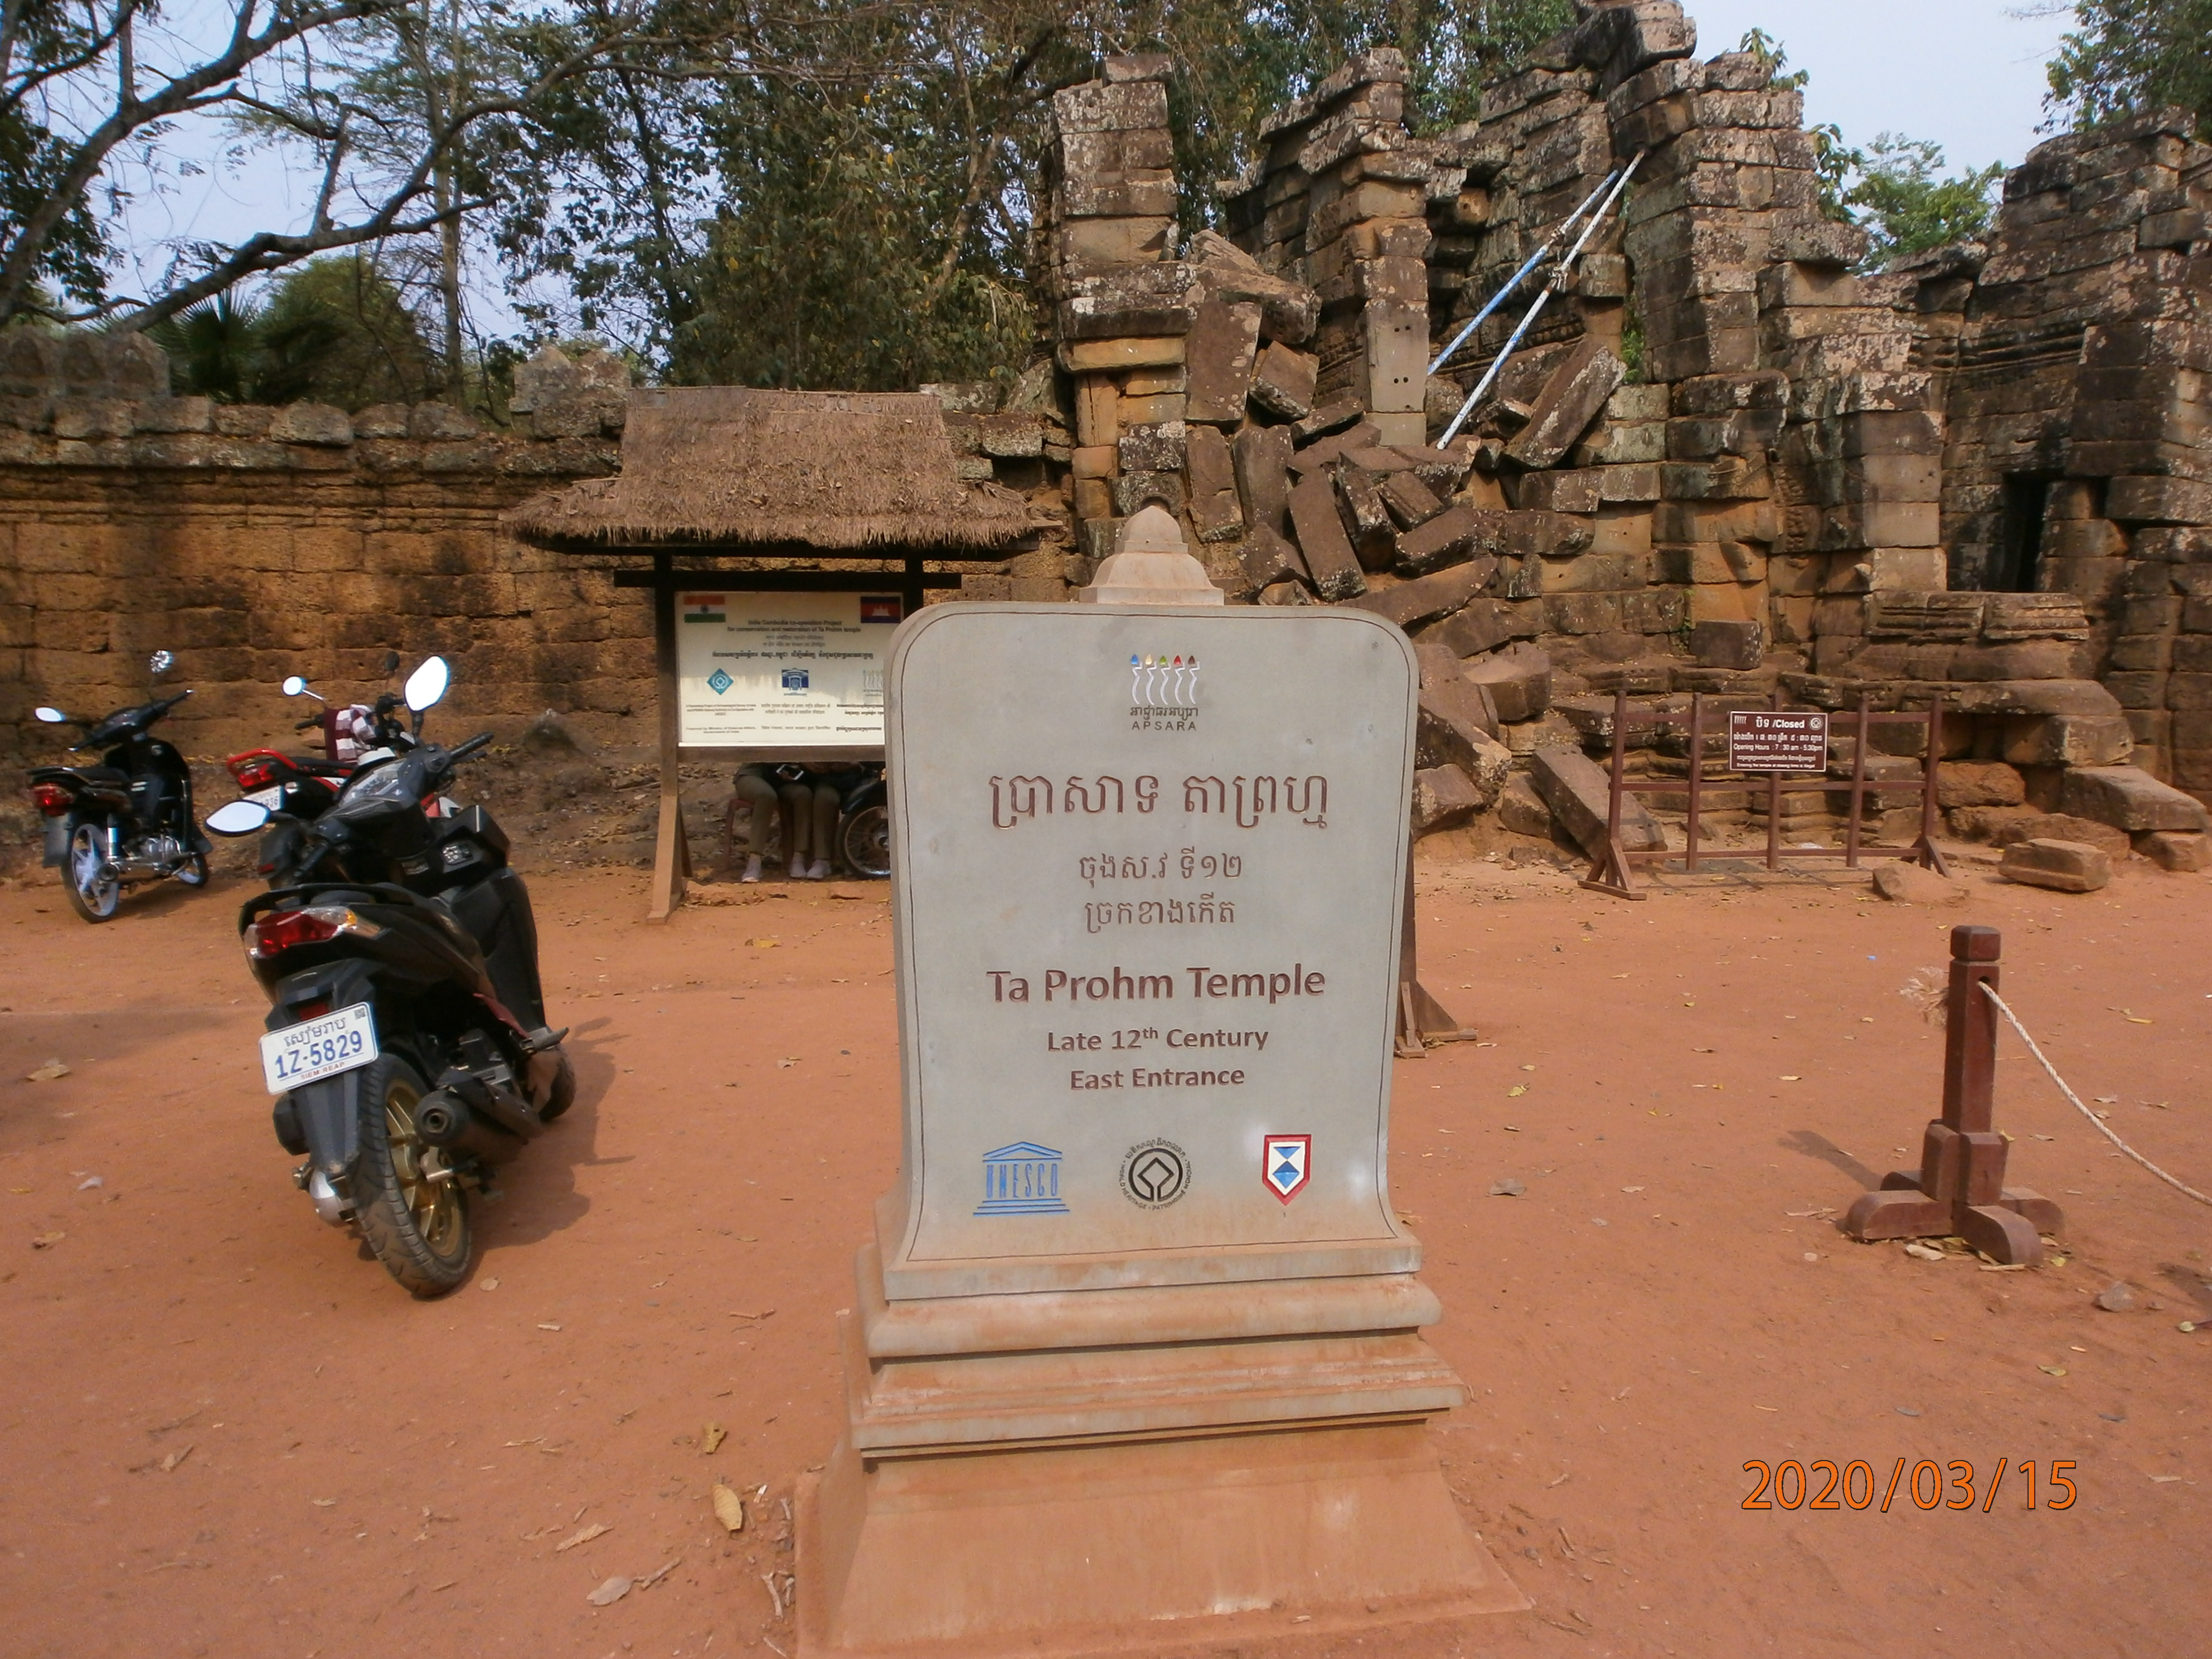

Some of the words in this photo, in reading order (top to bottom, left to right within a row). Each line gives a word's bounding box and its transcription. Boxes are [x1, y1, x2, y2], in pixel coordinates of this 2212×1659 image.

[1132, 720, 1196, 731] APSARA
[1734, 743, 1754, 751] Opening
[988, 775, 1159, 831] ប្រាសាទ
[1182, 775, 1327, 830] តាព្រហ្ម
[1084, 892, 1235, 933] ច្រកខាងកើត
[986, 971, 1029, 1003] Ta
[1045, 967, 1173, 1002] Prohm
[1186, 963, 1326, 1004] Temple
[284, 1018, 346, 1047] សៀមរាប
[1048, 1032, 1102, 1052] Late
[1112, 1027, 1159, 1050] 12th
[1166, 1029, 1269, 1051] Century
[300, 1069, 320, 1080] SIEM
[322, 1061, 345, 1073] REAP
[1070, 1070, 1124, 1090] East
[1132, 1068, 1245, 1088] Entrance
[986, 1163, 1058, 1198] UNESCO
[1152, 1190, 1186, 1211] PATRIMOINE
[1183, 1161, 1192, 1190] MONDIAL
[1122, 1187, 1147, 1210] HERITAGE
